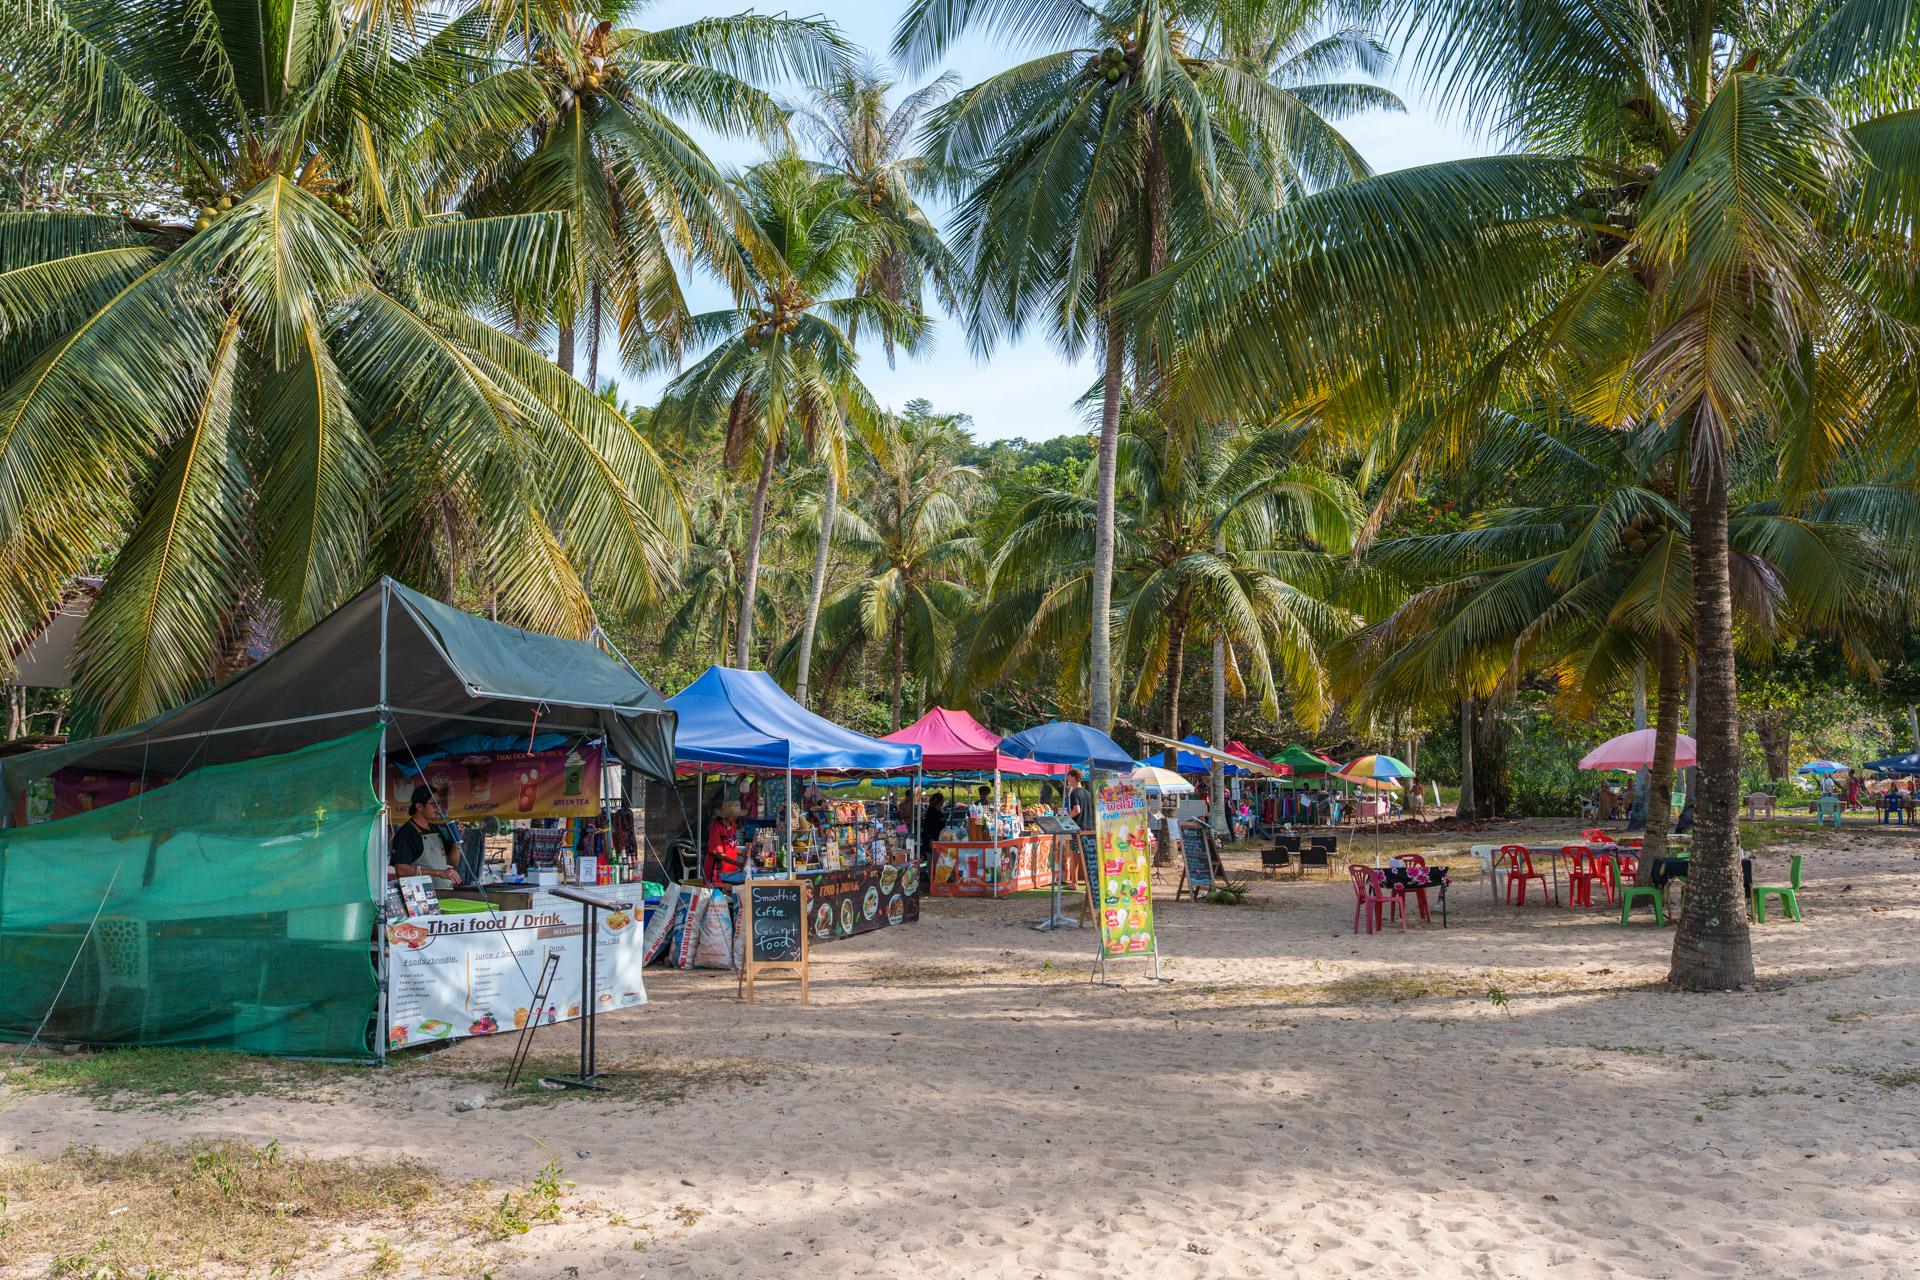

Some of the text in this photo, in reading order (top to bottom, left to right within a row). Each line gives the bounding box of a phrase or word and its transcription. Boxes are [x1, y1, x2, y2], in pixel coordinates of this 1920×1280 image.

[752, 888, 797, 902] Smoothie
[820, 885, 835, 897] FOOD
[840, 881, 859, 893] DRINK
[428, 919, 464, 934] Thai
[469, 916, 507, 931] food
[524, 912, 564, 927] Drink.
[756, 936, 795, 951] food
[475, 952, 494, 960] Juice
